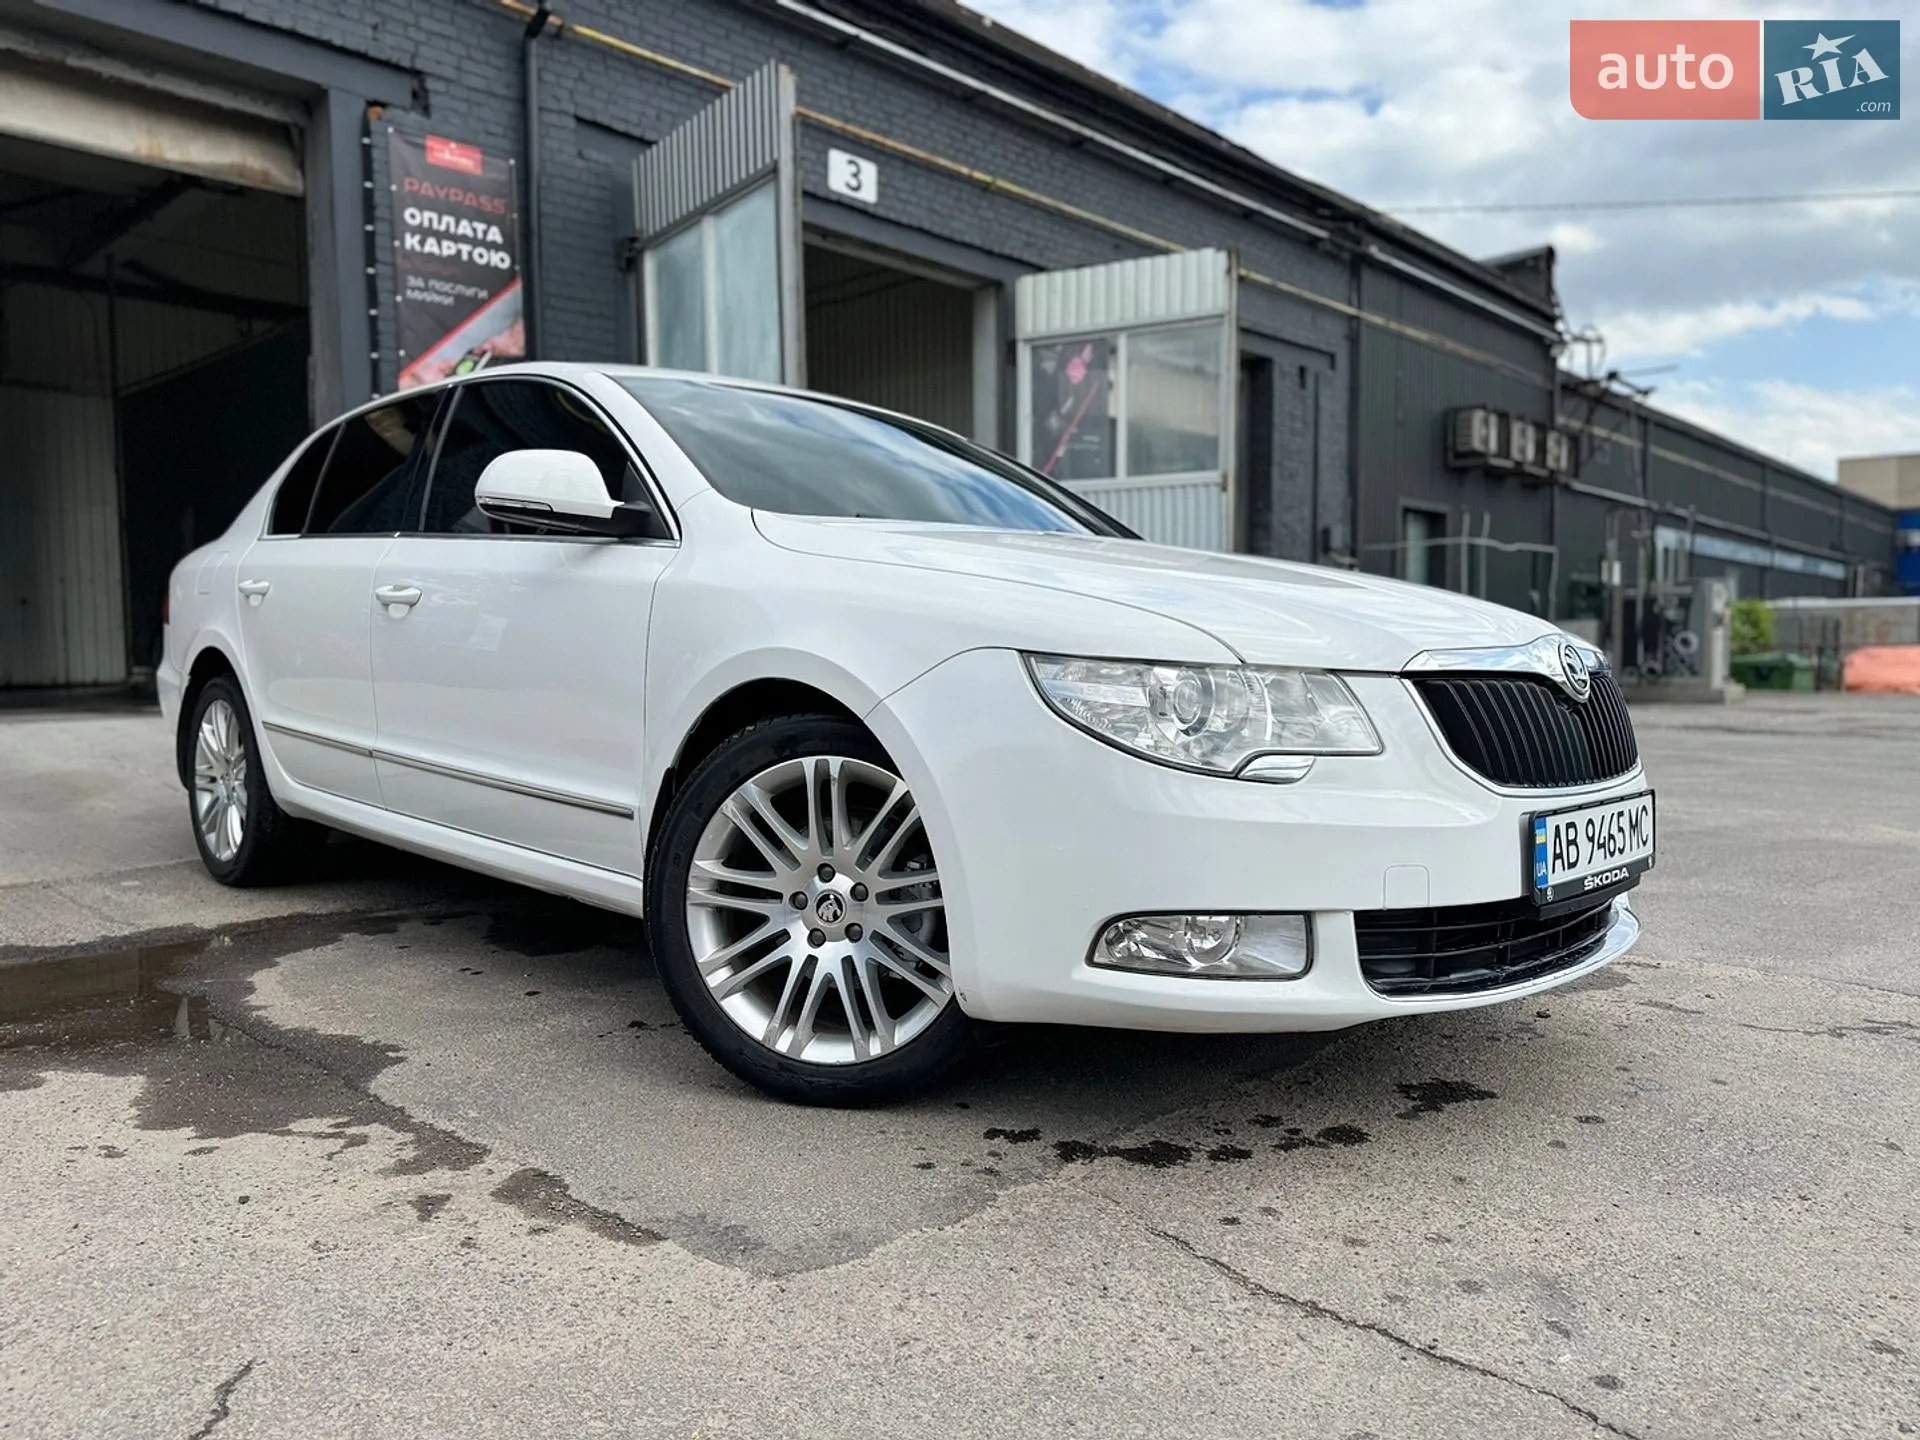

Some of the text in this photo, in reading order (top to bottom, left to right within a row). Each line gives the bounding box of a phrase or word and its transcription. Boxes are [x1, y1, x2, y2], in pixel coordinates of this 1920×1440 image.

[845, 160, 862, 192] 3
[403, 207, 503, 244] ОПЛАТА
[404, 232, 511, 269] КАРТОЮ
[1551, 805, 1649, 874] AB 9465 MC
[1583, 867, 1629, 891] ŠKODA
